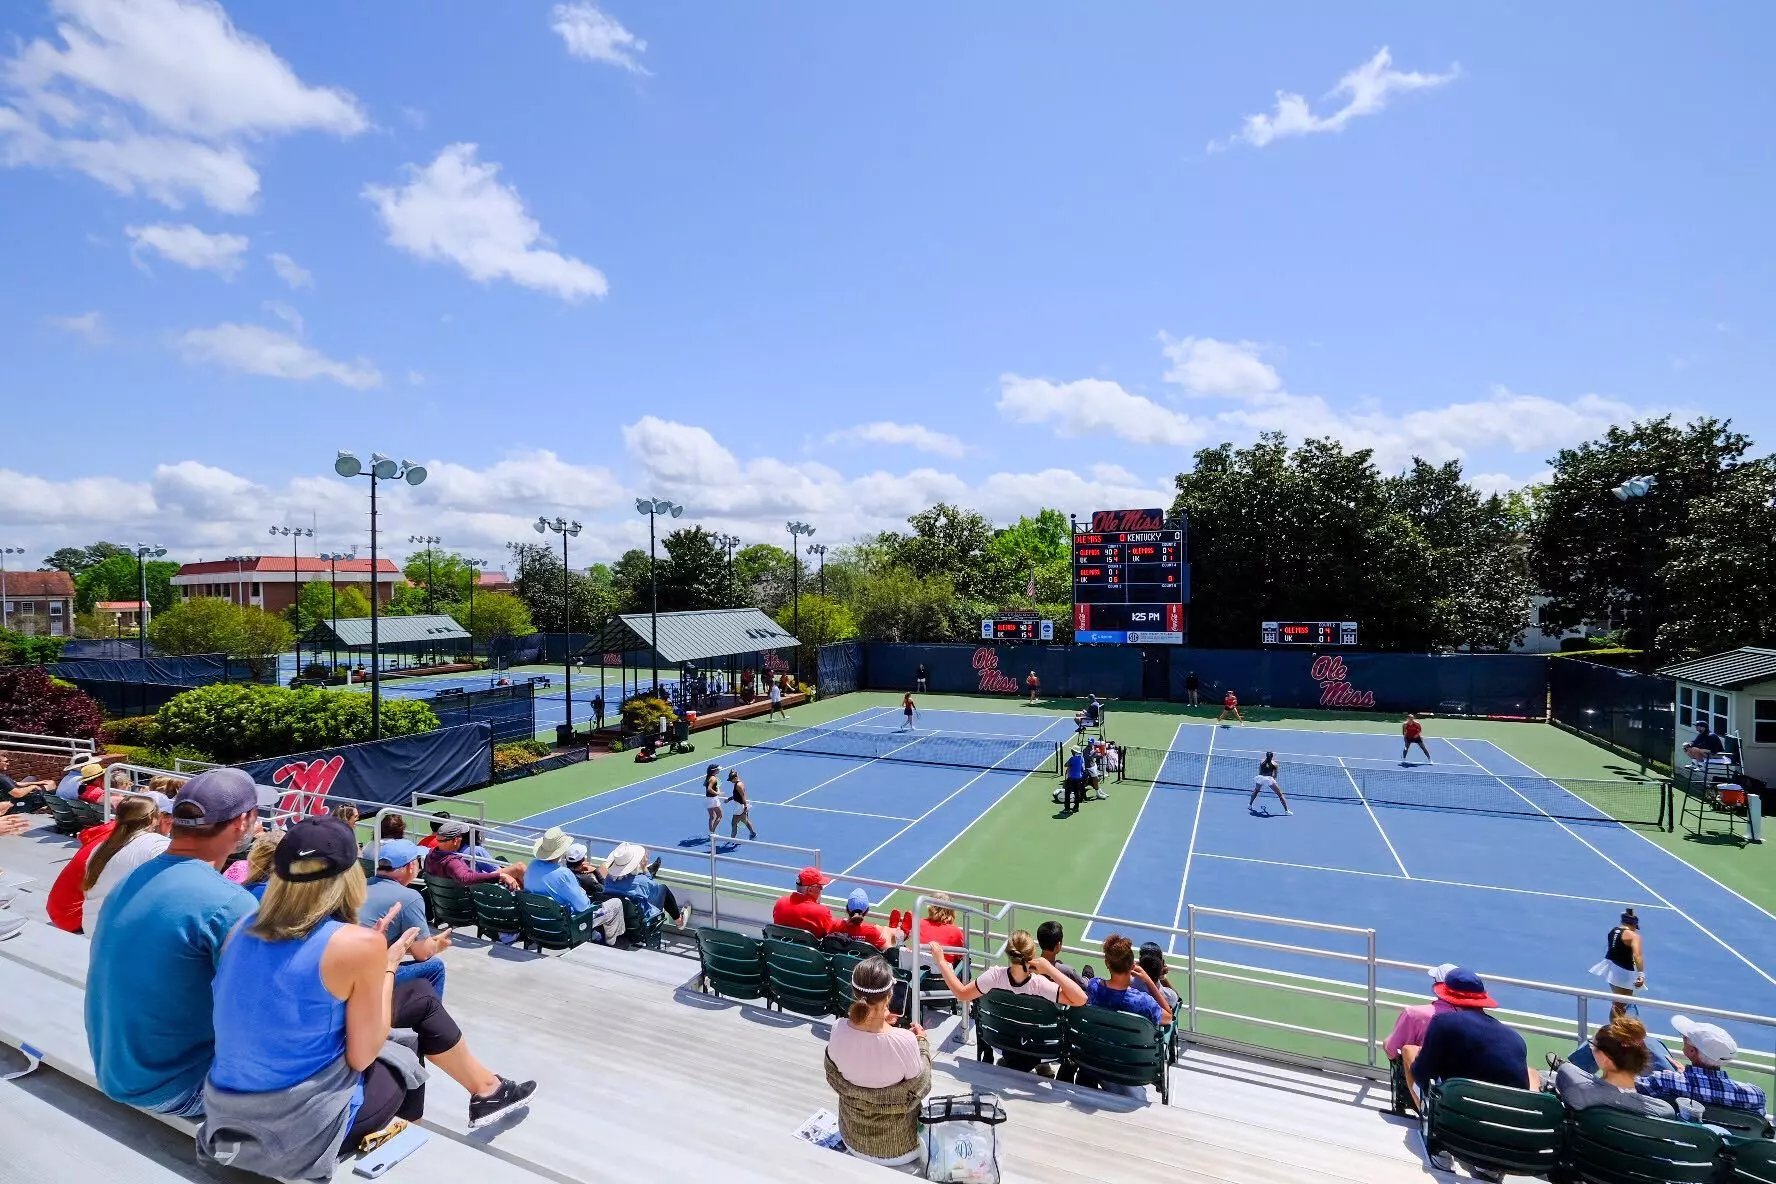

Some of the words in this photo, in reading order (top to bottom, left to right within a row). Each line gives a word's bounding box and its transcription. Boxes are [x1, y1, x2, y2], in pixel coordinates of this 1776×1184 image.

[1093, 511, 1119, 532] Ole
[1119, 509, 1161, 531] Miss
[1127, 533, 1162, 541] KENTUCKY
[1174, 531, 1180, 540] 0
[1162, 554, 1167, 562] 0
[1148, 612, 1160, 621] PM
[1284, 634, 1293, 642] UK
[1318, 635, 1324, 643] 0
[1318, 627, 1324, 635] 0
[972, 647, 999, 670] Ole
[1310, 655, 1348, 680] Ole
[978, 668, 1019, 692] Miss
[1319, 680, 1376, 707] Miss
[272, 755, 345, 827] M
